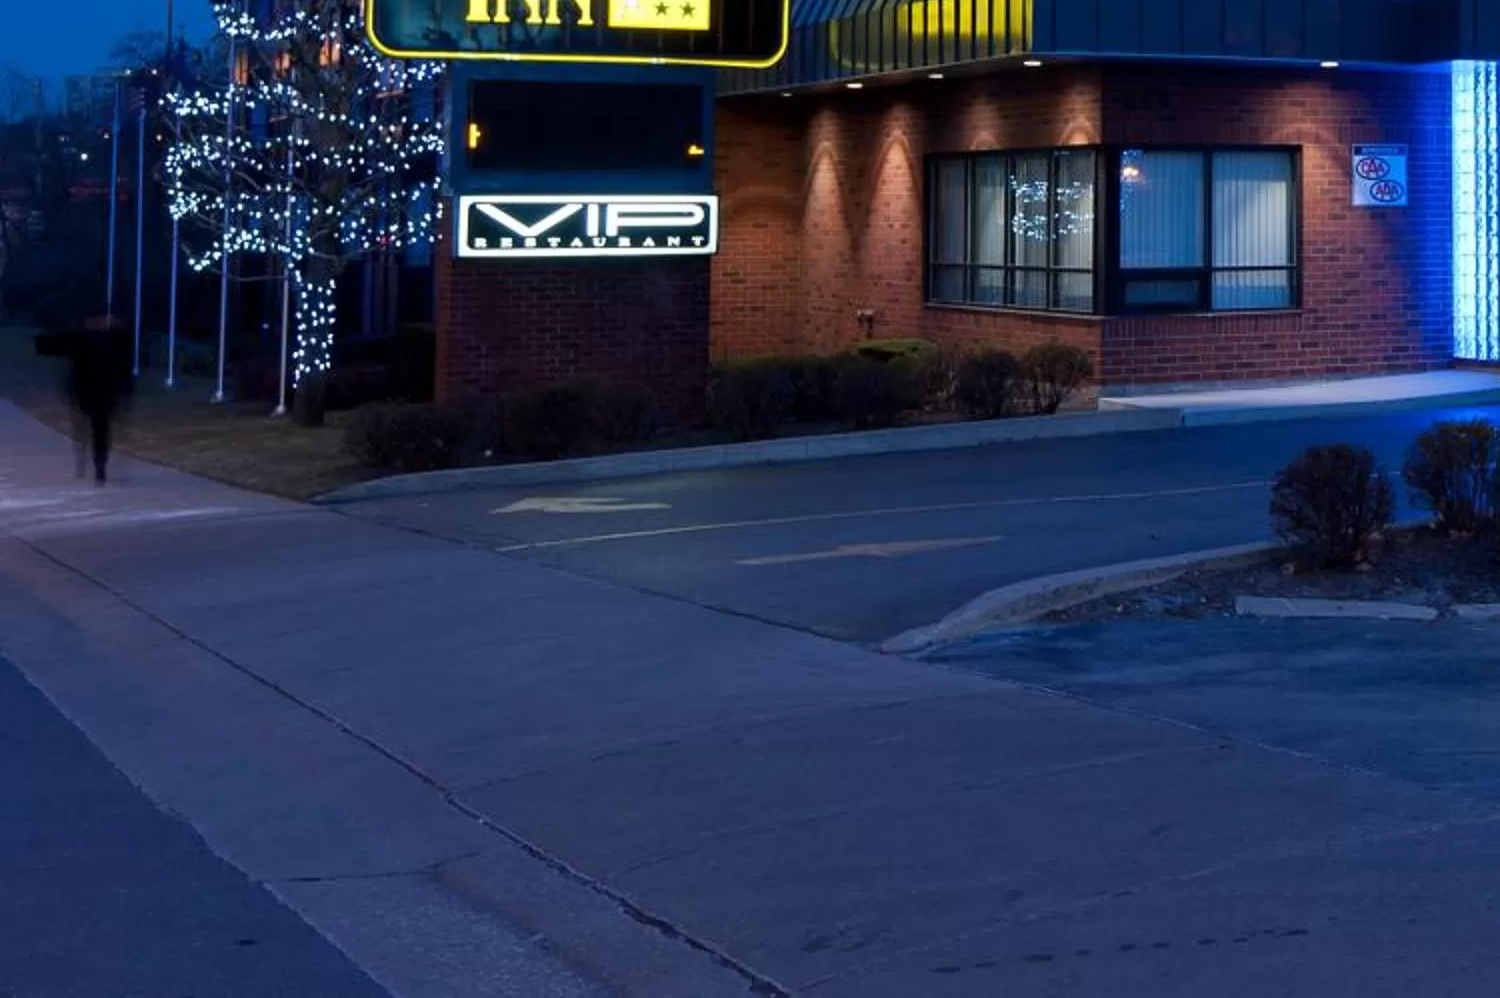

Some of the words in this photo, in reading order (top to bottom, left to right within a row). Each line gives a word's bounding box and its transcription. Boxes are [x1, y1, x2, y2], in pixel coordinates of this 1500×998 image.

[1359, 159, 1387, 176] CAA
[1375, 183, 1400, 198] AAA
[476, 203, 705, 238] VIP
[474, 236, 705, 248] RESTAURANT
